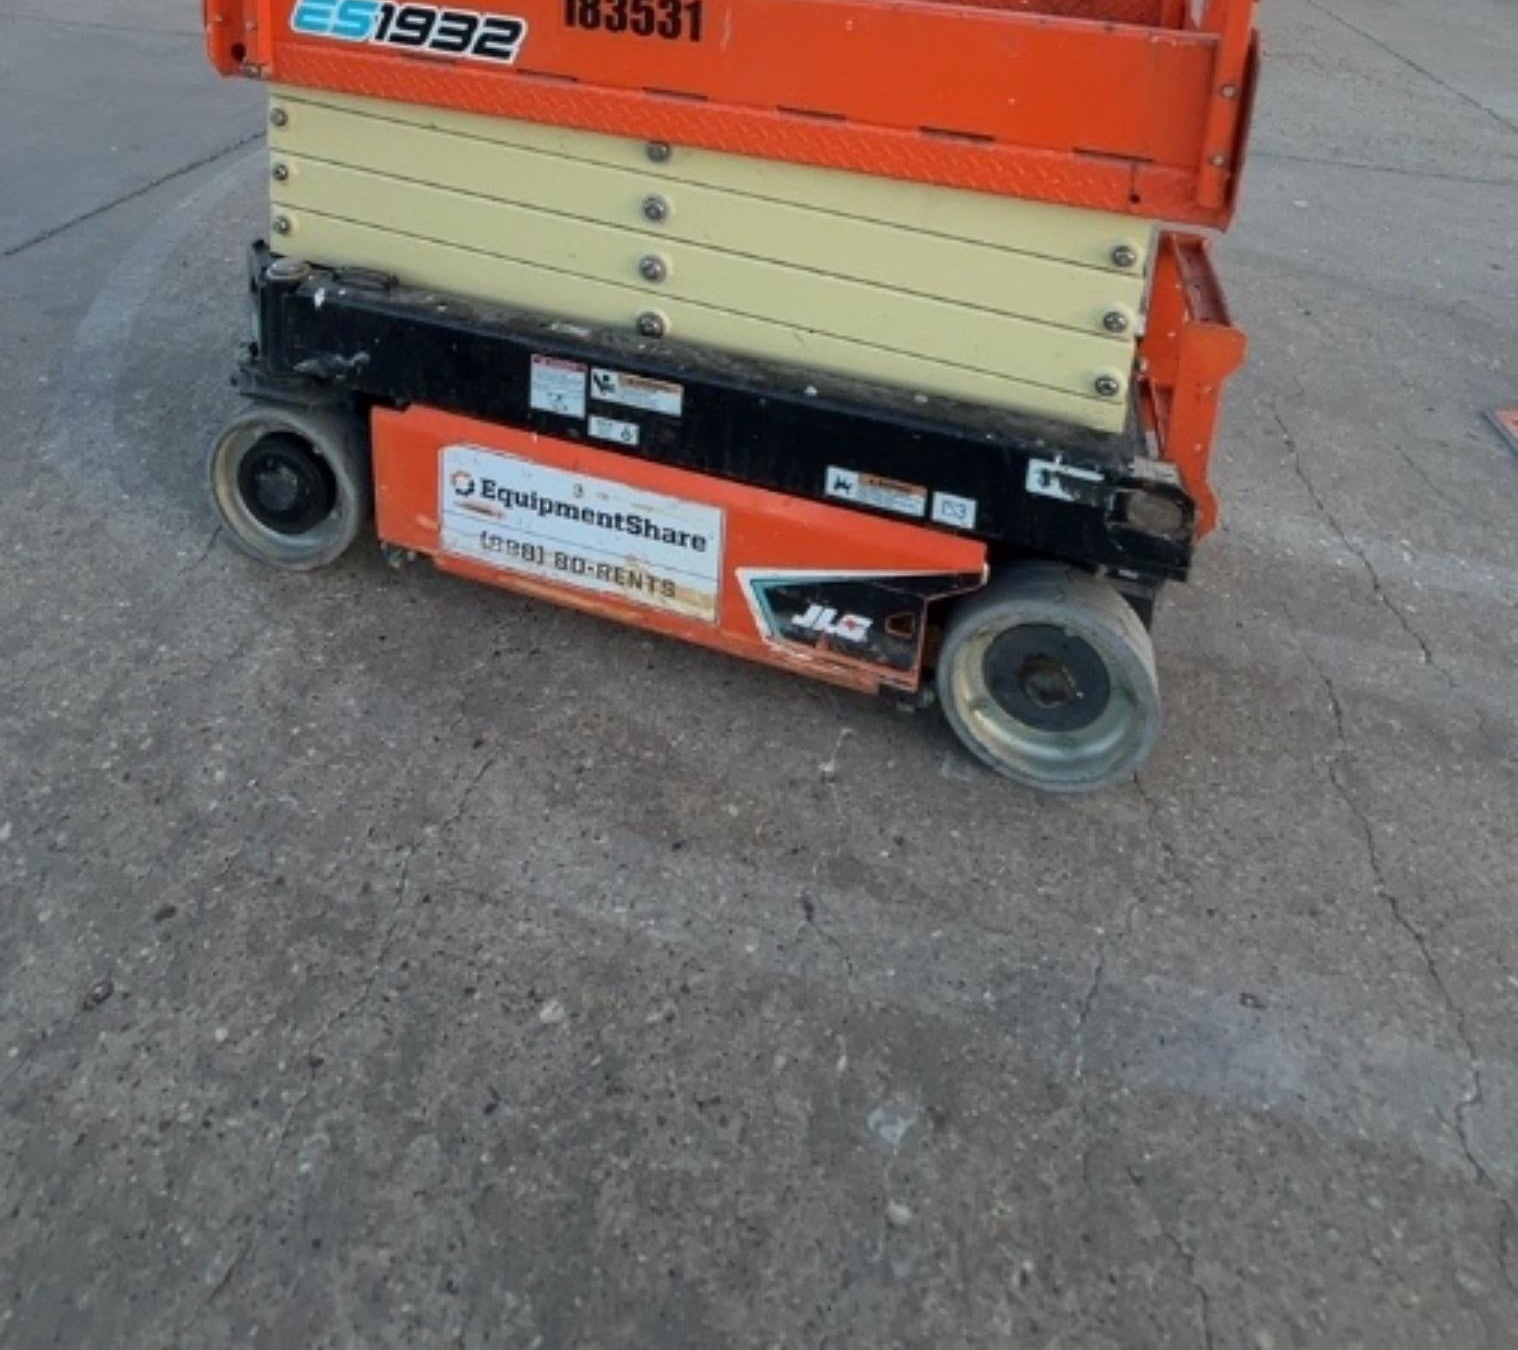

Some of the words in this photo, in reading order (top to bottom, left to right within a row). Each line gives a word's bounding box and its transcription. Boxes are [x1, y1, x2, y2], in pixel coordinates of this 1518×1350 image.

[480, 478, 707, 552] EquipmentShare
[554, 552, 676, 598] 80-RENTS
[791, 603, 874, 642] JLG
